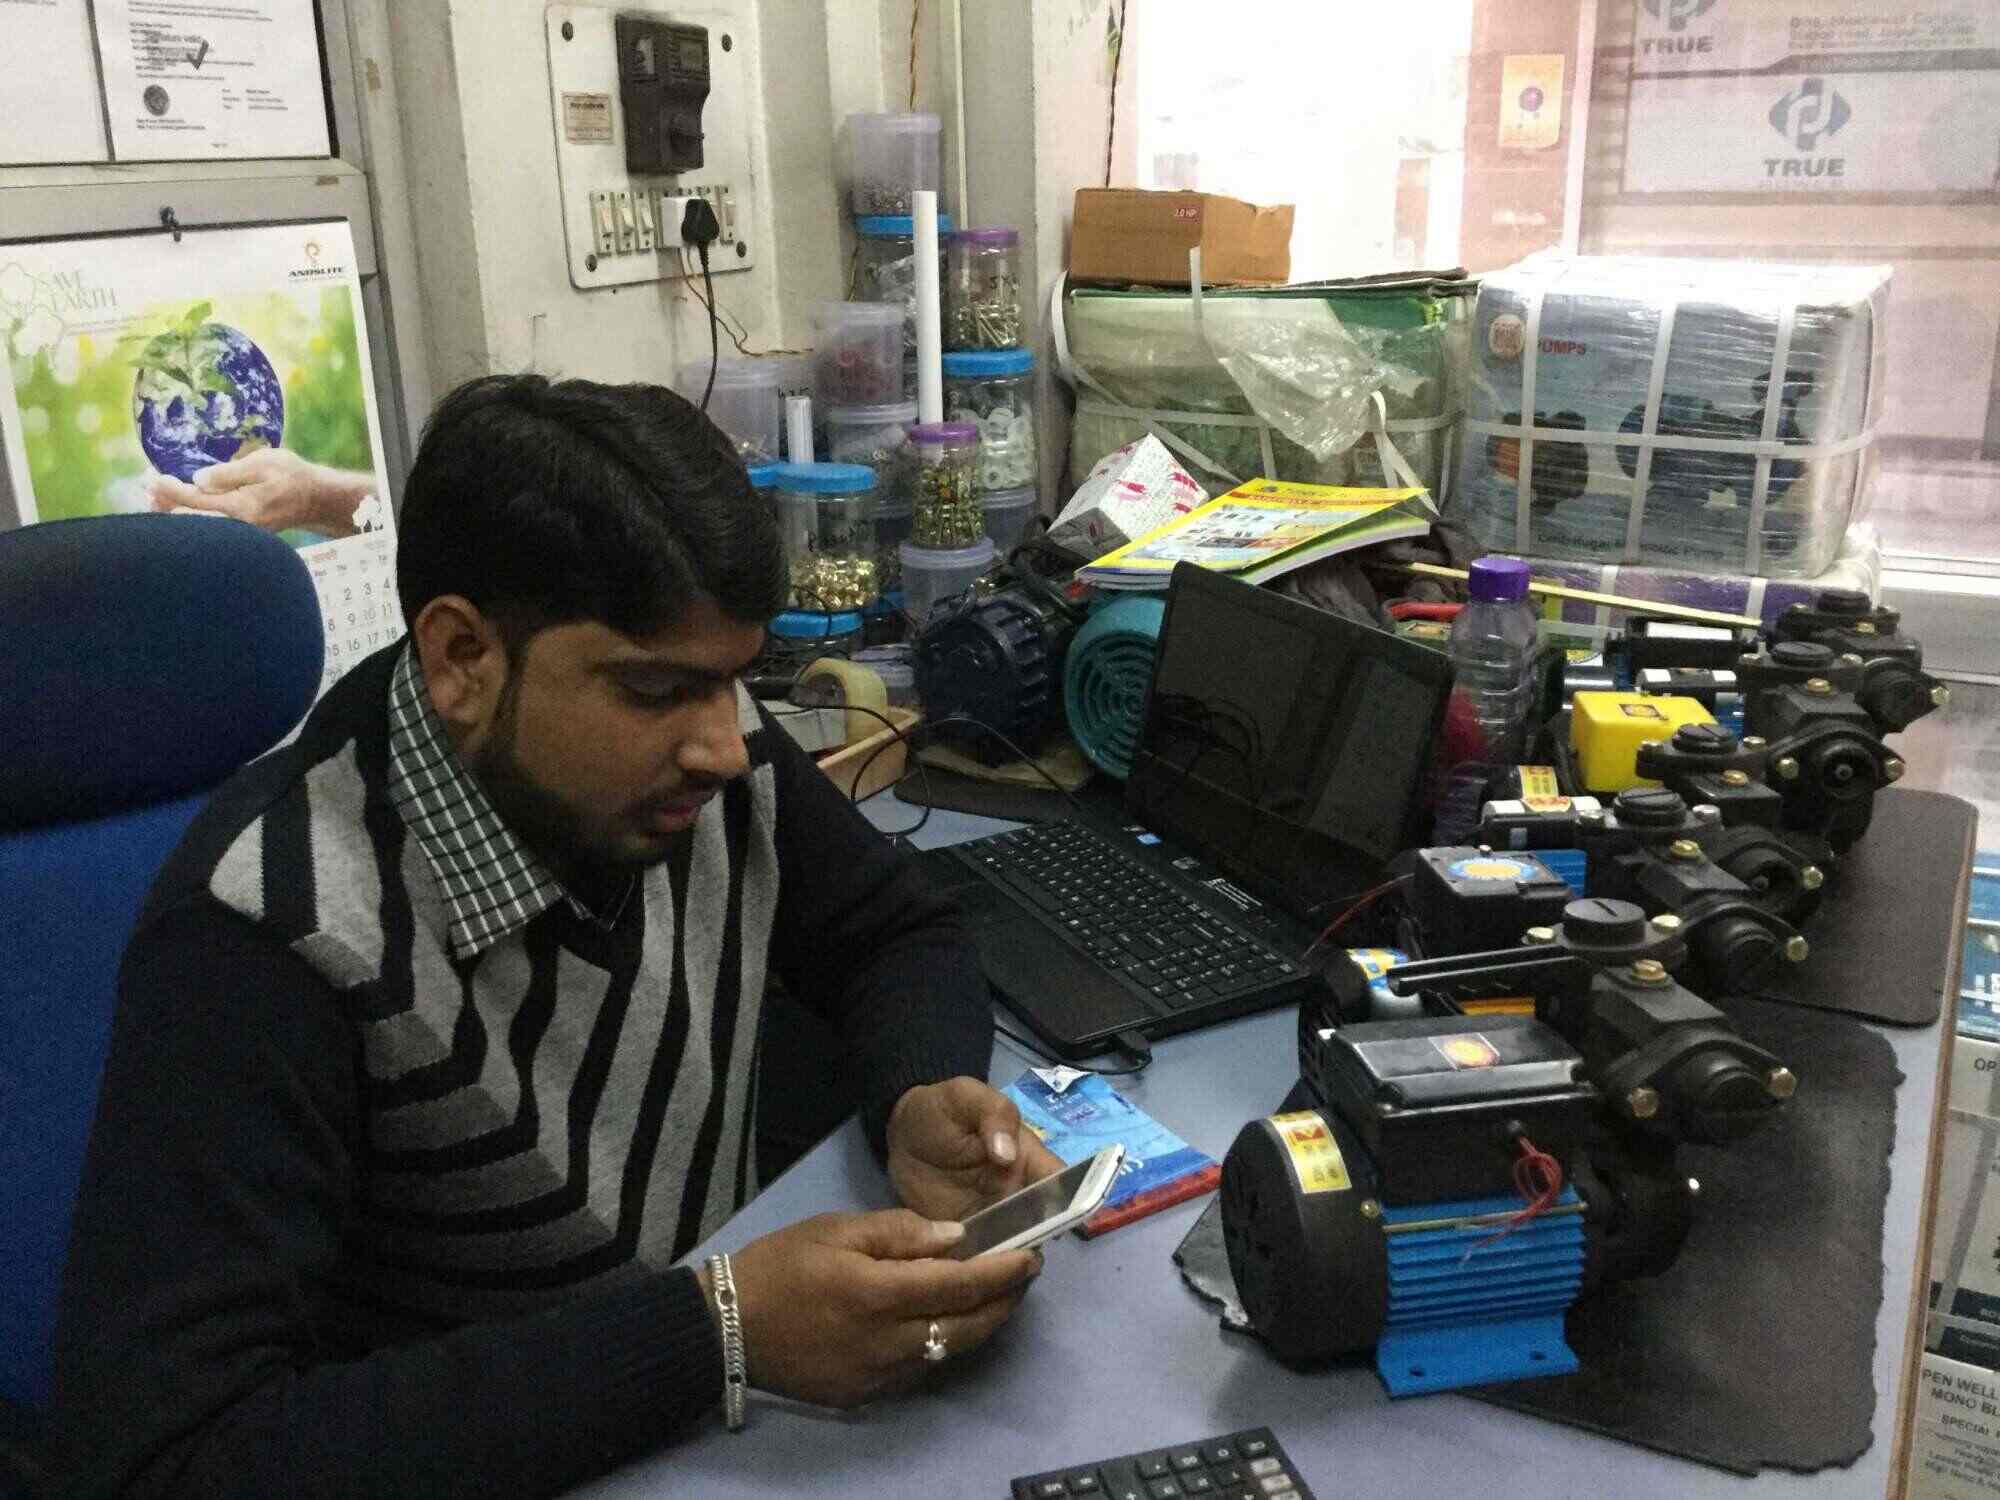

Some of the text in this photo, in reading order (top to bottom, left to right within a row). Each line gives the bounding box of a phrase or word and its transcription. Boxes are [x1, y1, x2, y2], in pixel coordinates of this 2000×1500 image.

[1640, 35, 1714, 54] TRUE
[1764, 157, 1845, 177] TRUE
[343, 586, 353, 601] 2
[363, 582, 372, 596] 3
[347, 612, 356, 625] 9
[347, 638, 360, 652] 16
[367, 631, 379, 647] 17
[1931, 1386, 1978, 1410] MONO
[1940, 1412, 1990, 1436] SPECIAL
